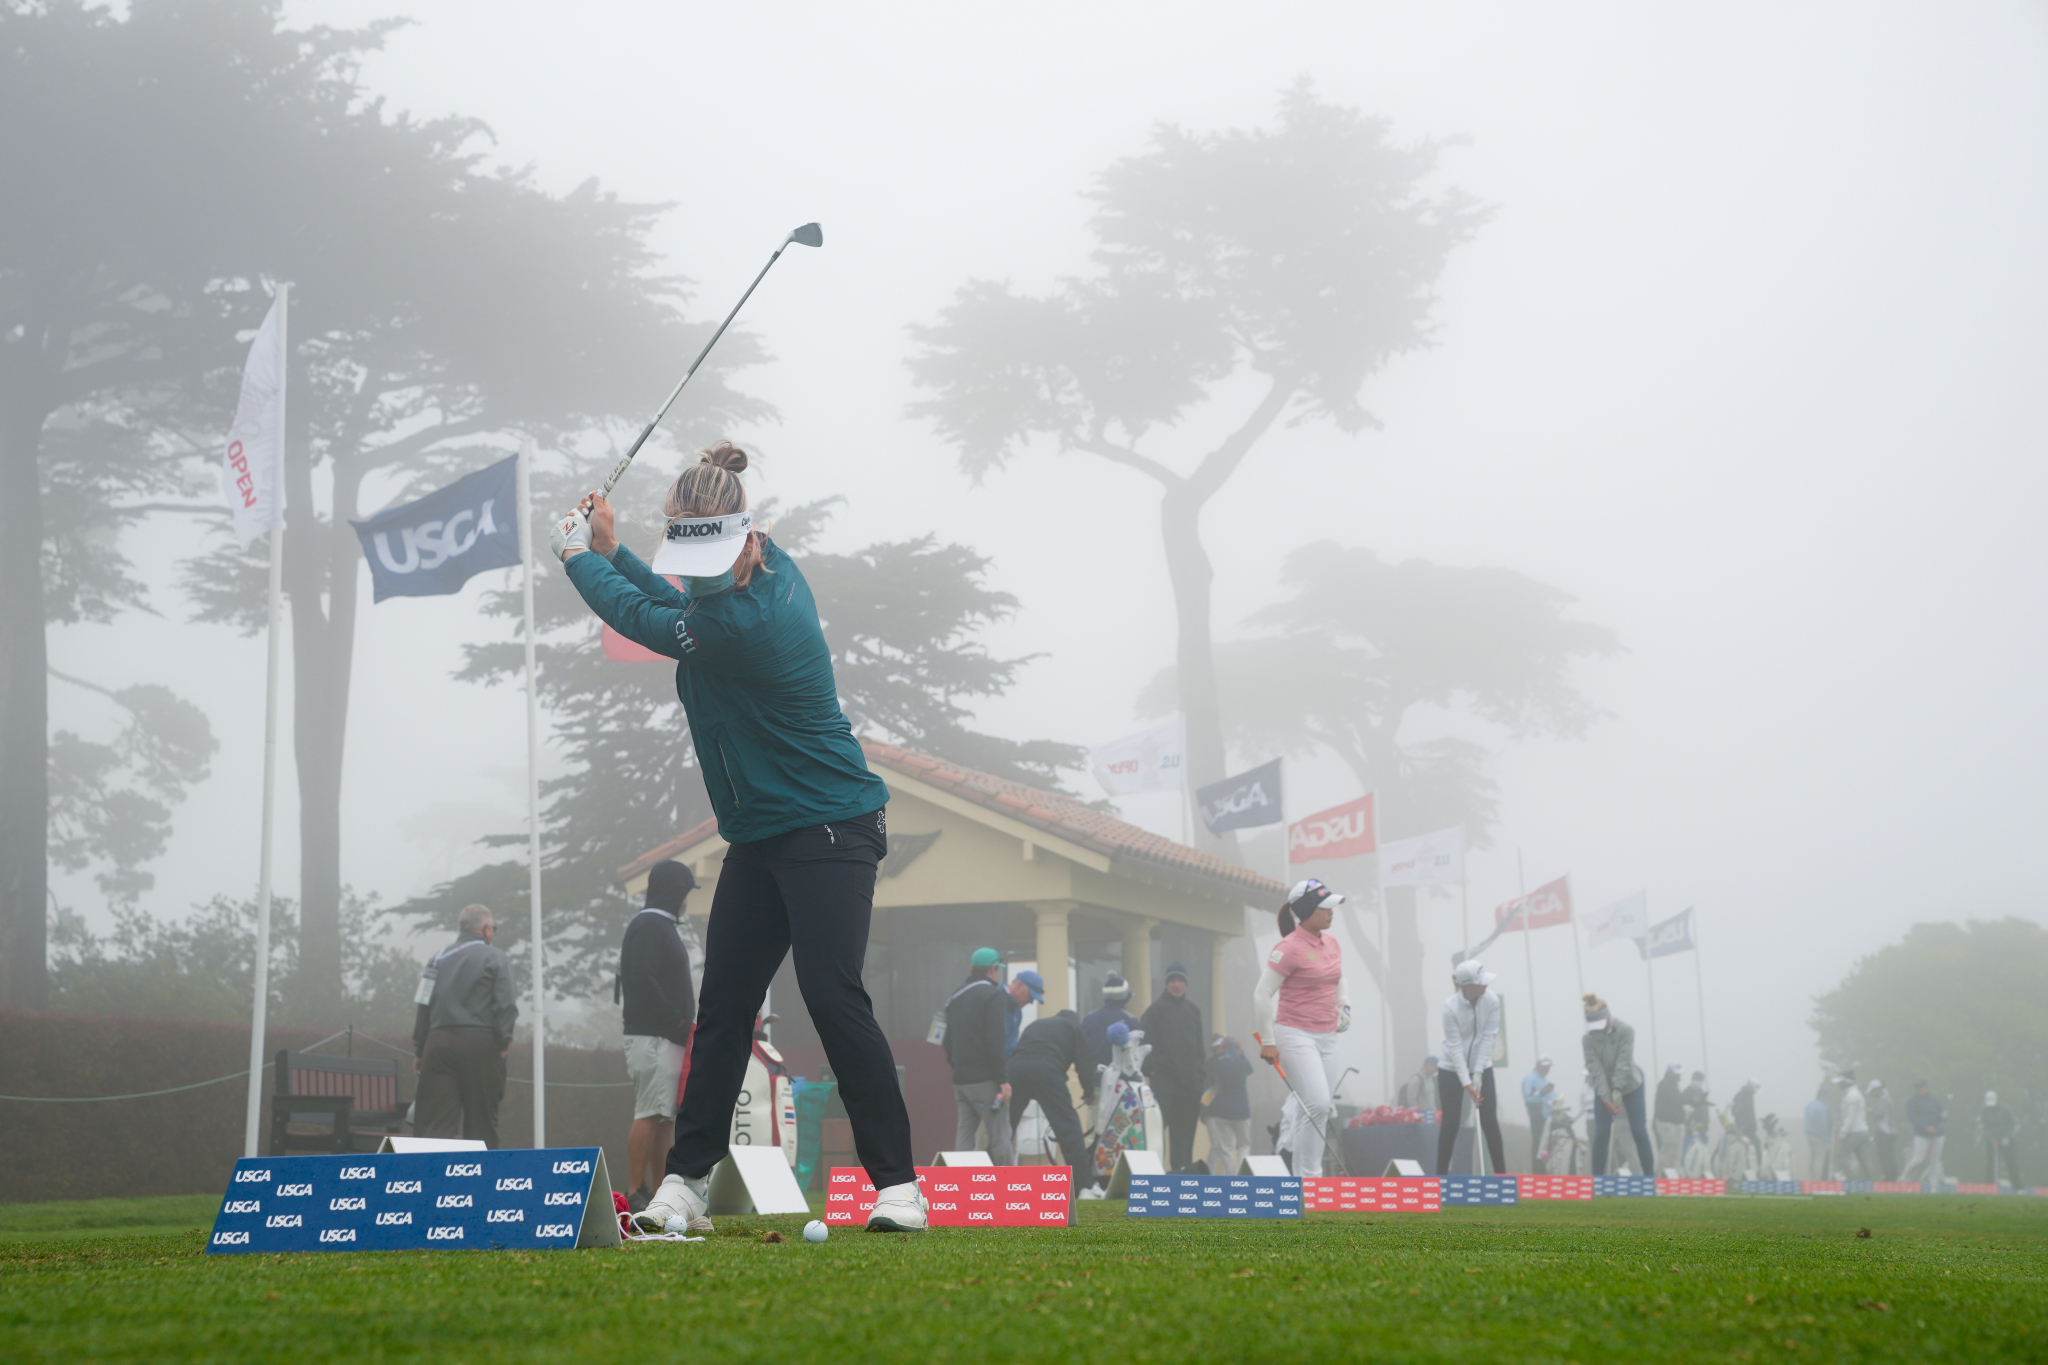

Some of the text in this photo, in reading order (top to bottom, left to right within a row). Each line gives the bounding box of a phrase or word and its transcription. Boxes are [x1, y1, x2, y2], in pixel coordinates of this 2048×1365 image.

[228, 440, 257, 508] OPEN
[676, 620, 696, 654] citi
[340, 1167, 375, 1179] USGA
[445, 1164, 482, 1177] USGA
[552, 1161, 590, 1174] USGA
[235, 1170, 271, 1182] USGA
[1043, 1174, 1068, 1182] USGA
[277, 1184, 312, 1196] USGA
[385, 1181, 422, 1193] USGA
[496, 1178, 532, 1191] USGA
[436, 1195, 473, 1208] USGA
[544, 1192, 581, 1205] USGA
[1041, 1193, 1066, 1201] USGA
[224, 1201, 260, 1213] USGA
[330, 1198, 366, 1210] USGA
[1005, 1202, 1031, 1210] USGA
[266, 1215, 302, 1227] USGA
[376, 1212, 412, 1225] USGA
[487, 1209, 524, 1222] USGA
[319, 1229, 356, 1242] USGA
[427, 1227, 464, 1240] USGA
[536, 1224, 573, 1237] USGA
[213, 1232, 249, 1244] USGA
